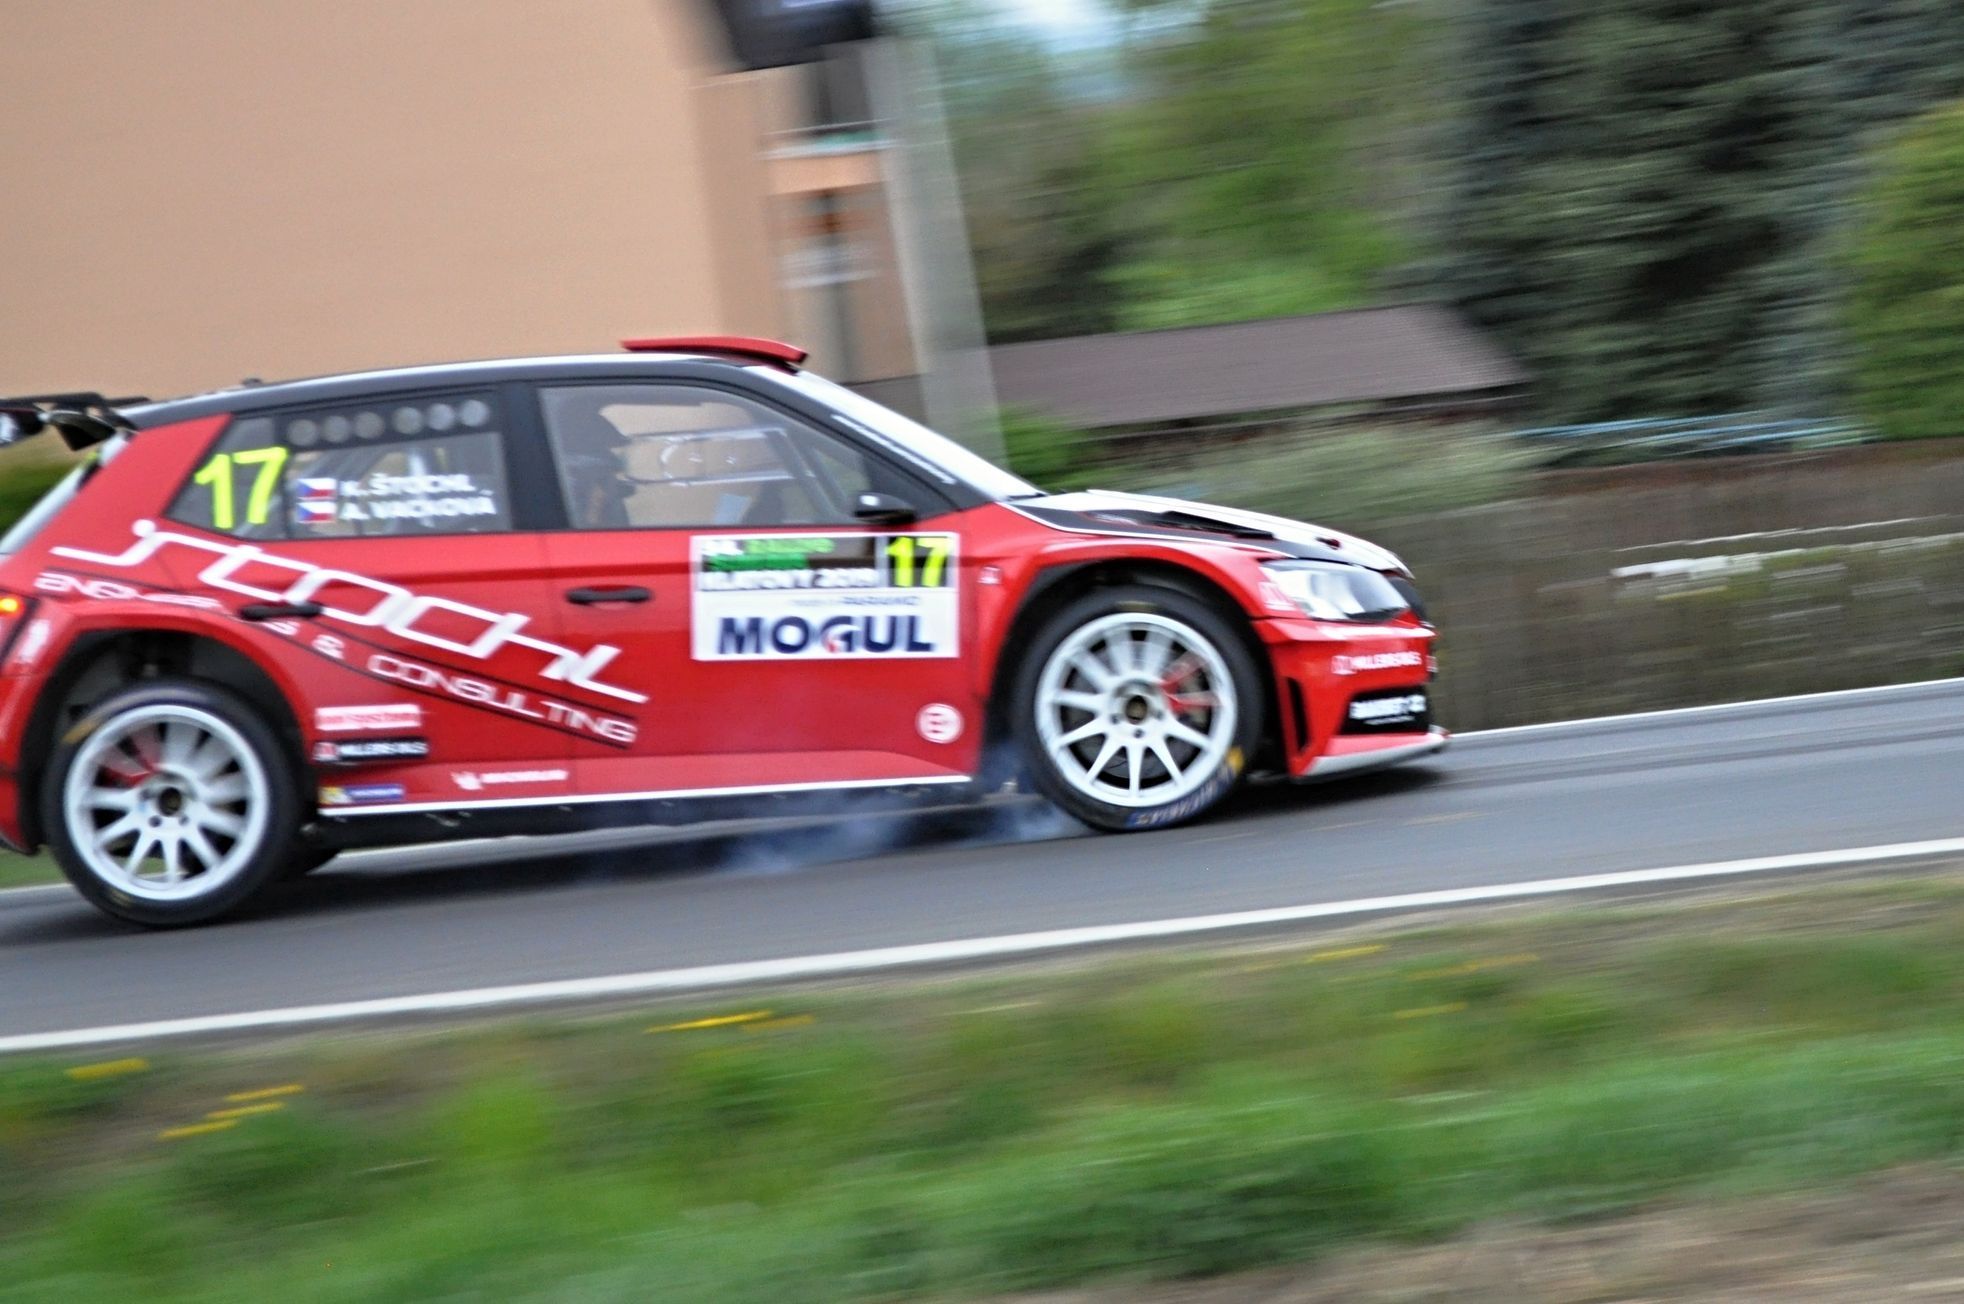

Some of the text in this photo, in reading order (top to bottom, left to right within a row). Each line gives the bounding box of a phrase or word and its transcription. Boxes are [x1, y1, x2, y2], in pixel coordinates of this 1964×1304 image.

[194, 446, 288, 529] 17
[885, 535, 951, 588] 17
[716, 614, 936, 655] MOGUL
[366, 654, 640, 745] CONSULTING
